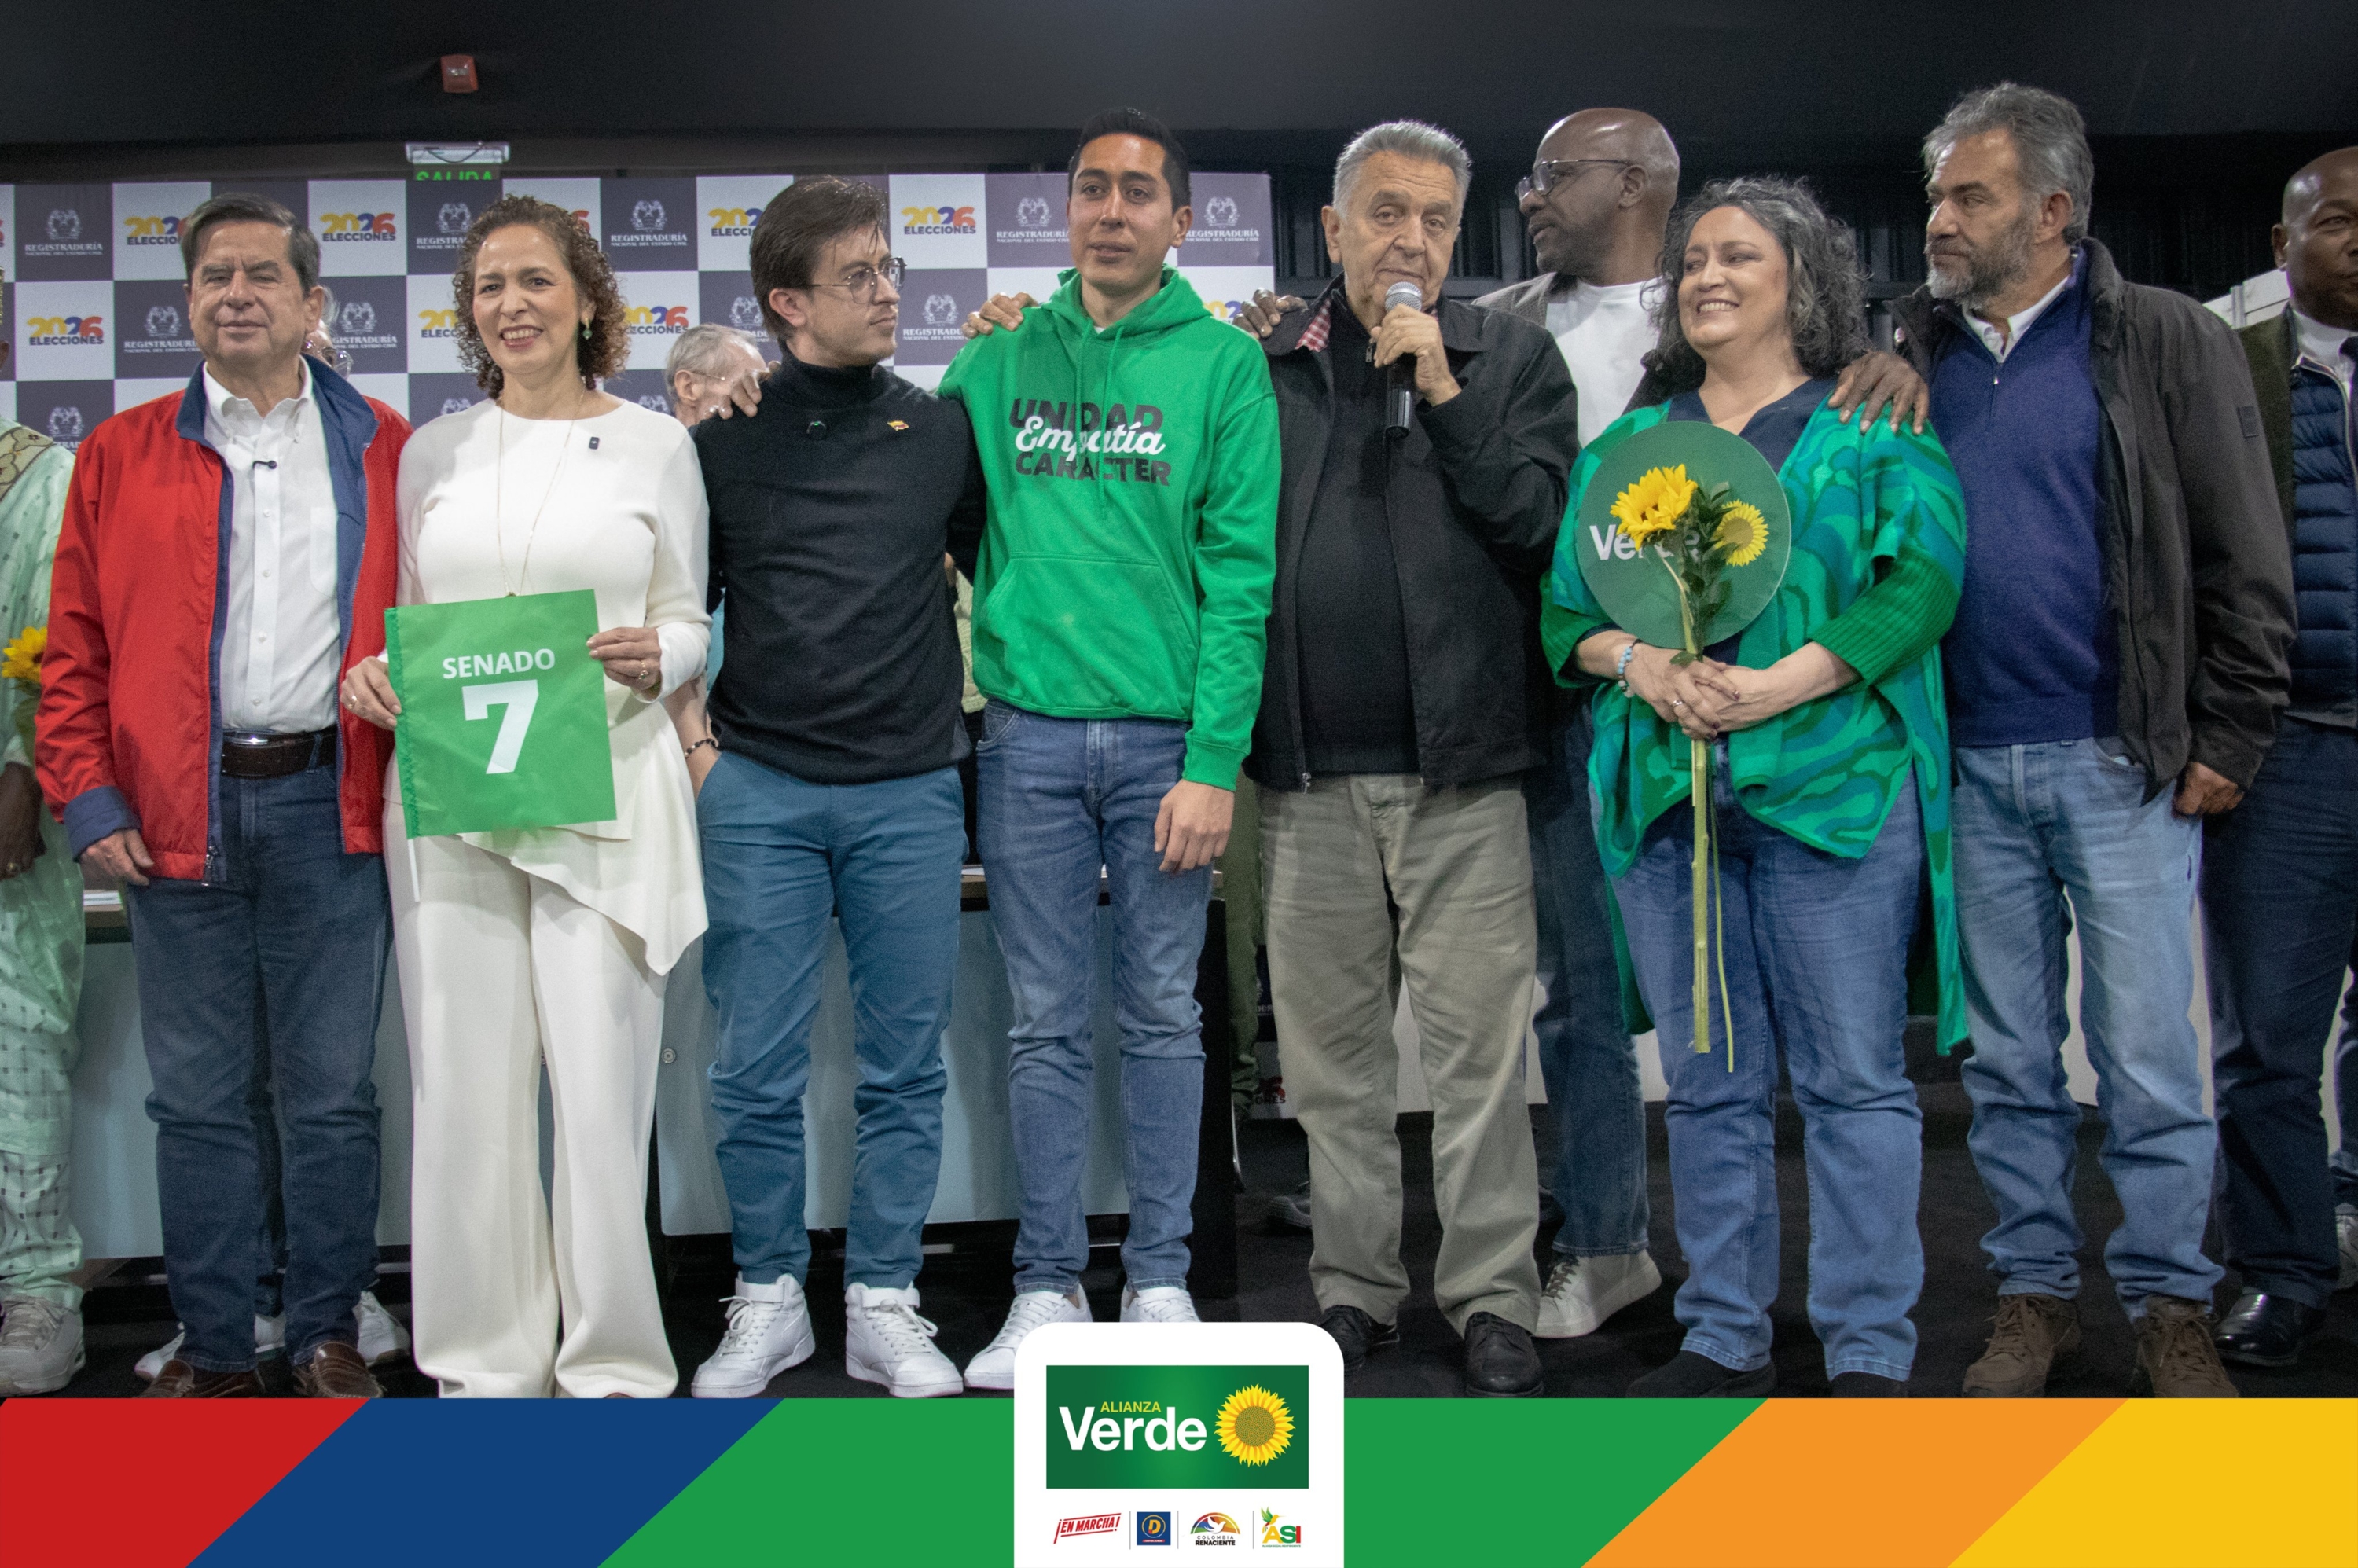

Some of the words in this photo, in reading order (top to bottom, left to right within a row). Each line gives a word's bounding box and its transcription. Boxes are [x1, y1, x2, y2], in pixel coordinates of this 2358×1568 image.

[320, 212, 396, 234] 2026
[708, 207, 763, 229] 202
[901, 206, 976, 226] 2026
[322, 233, 396, 242] ELECCIONES
[611, 232, 688, 241] REGISTRADURÍA
[904, 225, 976, 235] ELECCIONES
[24, 241, 103, 252] REGISTRADURÍA
[127, 236, 178, 245] ELECCIO
[417, 237, 466, 245] REGISTRA
[27, 316, 104, 337] 2026
[418, 309, 458, 329] 20
[421, 329, 457, 338] ELECC
[628, 325, 688, 334] ECCIONES
[29, 336, 104, 346] ELECCIONES
[332, 334, 397, 343] GISTRADURÍA
[1009, 398, 1164, 434] UNIDAD
[1016, 415, 1166, 461] Empatía
[1016, 451, 1172, 487] CARACTER
[442, 648, 556, 679] SENADO
[462, 679, 539, 774] 7
